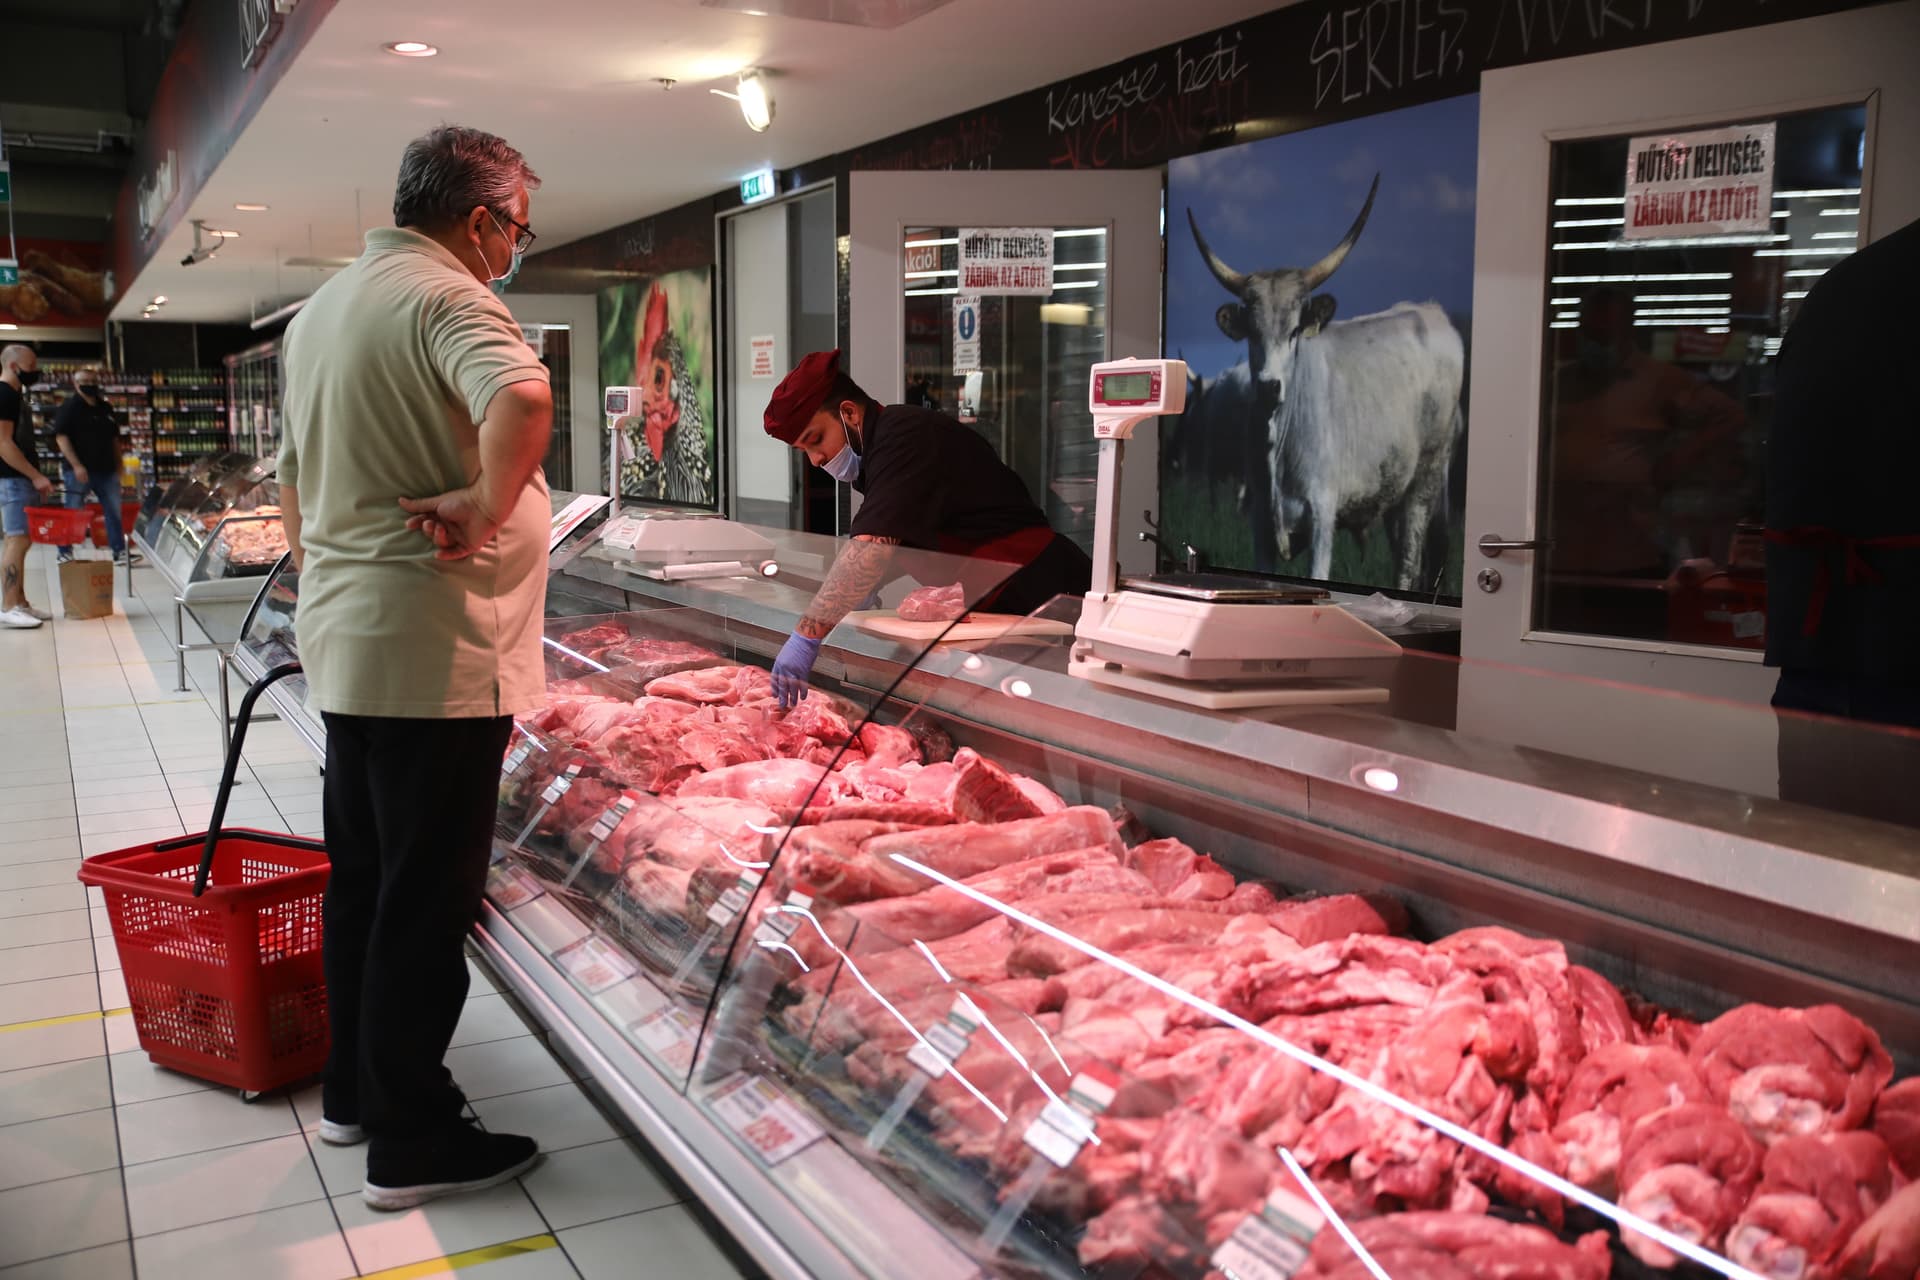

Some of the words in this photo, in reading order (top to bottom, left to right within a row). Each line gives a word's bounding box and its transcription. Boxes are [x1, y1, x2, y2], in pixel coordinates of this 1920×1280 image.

[1046, 62, 1166, 134] Keresse
[1176, 30, 1248, 95] heti
[1636, 143, 1692, 183] HŰTÖTT
[1693, 135, 1766, 179] HELYISÉG:
[1633, 188, 1686, 227] ZÁRJUK
[1687, 189, 1707, 223] AZ
[1707, 181, 1760, 221] AJTÓT!
[965, 263, 999, 288] ZÁRJUK
[1001, 266, 1013, 288] AZ
[1014, 263, 1045, 288] AJTÓT!
